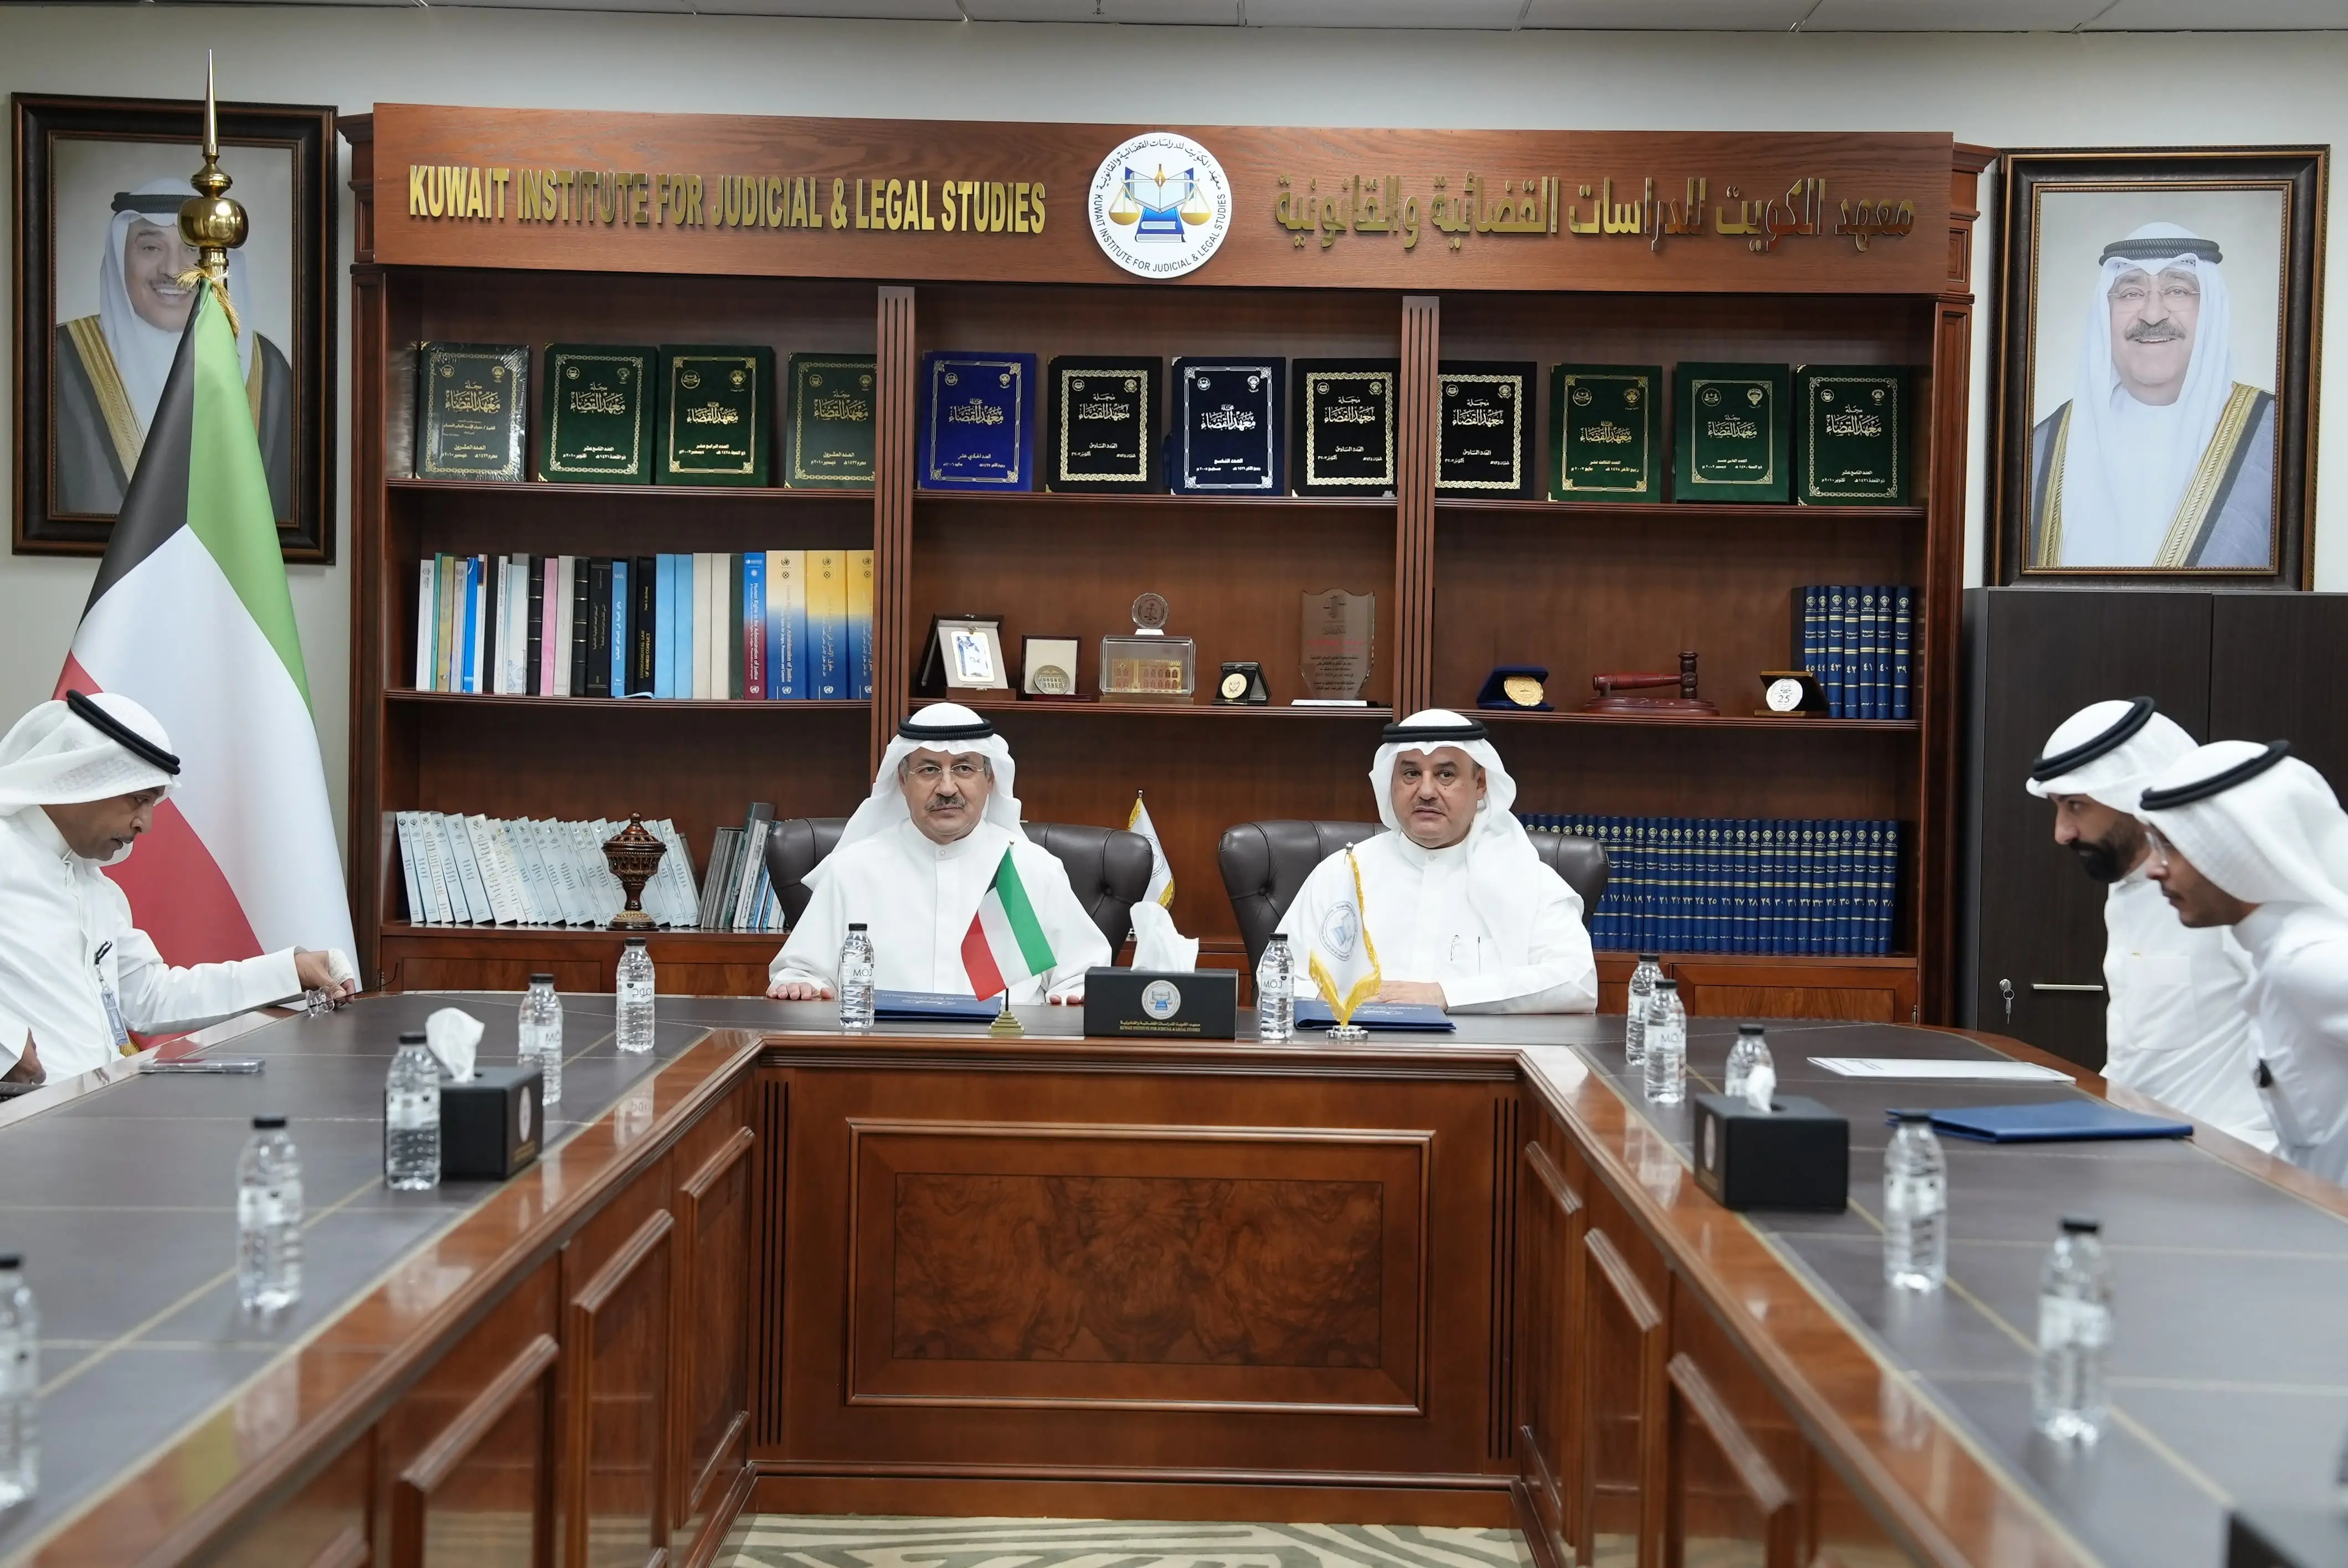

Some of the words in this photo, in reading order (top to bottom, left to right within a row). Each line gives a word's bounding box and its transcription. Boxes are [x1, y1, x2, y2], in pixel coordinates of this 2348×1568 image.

[1118, 140, 1149, 159] القضائية
[1150, 138, 1184, 149] للدراسات
[1185, 148, 1212, 168] الكويت
[1209, 169, 1222, 190] معهد
[410, 165, 509, 219] KUWAIT
[517, 168, 648, 223] INSTITUTE
[656, 174, 703, 225] FOR
[710, 175, 823, 228] JUDICIAL
[831, 178, 848, 229] &
[856, 179, 935, 230] LEGAL
[941, 180, 1046, 234] STUDIES
[1094, 194, 1105, 226] KUWAIT
[1214, 194, 1226, 230] STUDIES
[1275, 172, 1420, 249] والقانونية
[1431, 171, 1559, 249] القضائية
[1569, 177, 1707, 251] للدراسات
[1716, 177, 1825, 251] الكويت
[1835, 198, 1914, 252] معهد
[1099, 228, 1134, 264] INSTITUTE
[1197, 233, 1219, 256] LEGAL
[1132, 259, 1150, 271] FOR
[1152, 258, 1191, 272] JUDICIAL
[1191, 254, 1199, 262] &
[1830, 663, 1841, 672] ٤٣
[1846, 666, 1857, 674] ٤٢
[1863, 663, 1873, 671] ٤١
[1880, 663, 1888, 672] ٤٠
[1897, 666, 1907, 674] ٣٩
[1778, 695, 1790, 703] 25
[632, 987, 652, 998] موج
